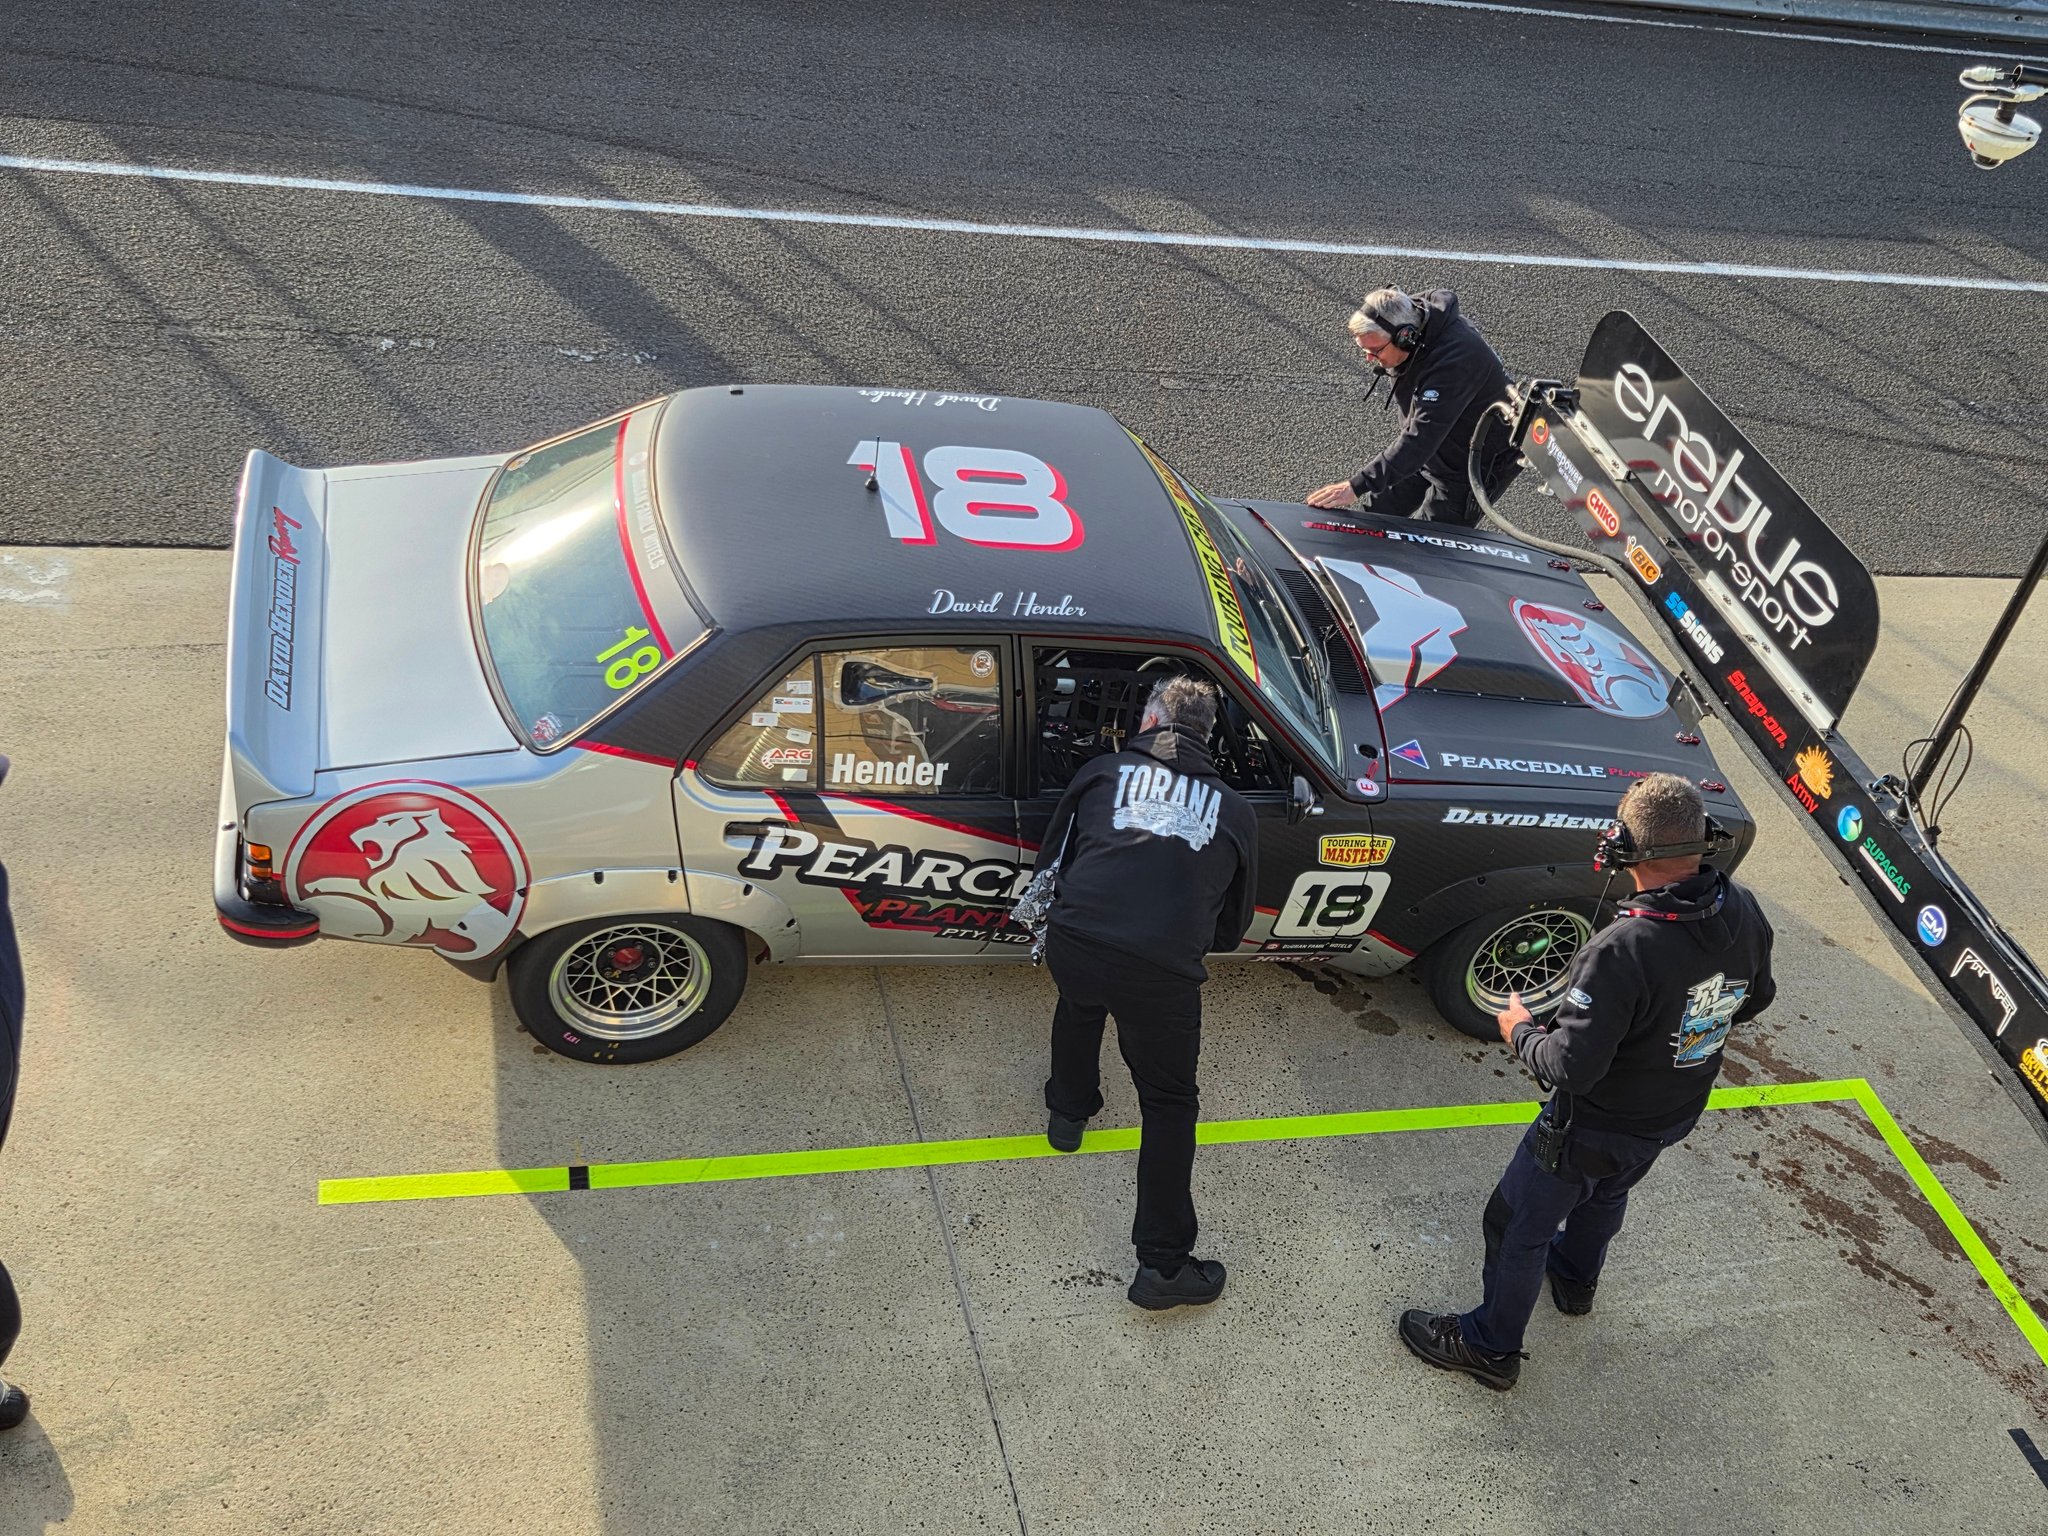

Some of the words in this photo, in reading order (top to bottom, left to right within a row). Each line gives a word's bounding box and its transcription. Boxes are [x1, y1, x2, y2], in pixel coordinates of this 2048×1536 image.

[846, 441, 1085, 552] 18
[1589, 494, 1617, 531] CHIKO
[1614, 363, 1839, 626] erebus
[1181, 505, 1215, 551] CAR
[1385, 530, 1532, 564] PEARCEDALE
[1655, 468, 1812, 650] motorsport
[269, 557, 297, 644] HENDER
[927, 589, 1004, 615] David
[1012, 589, 1088, 617] Hender
[1202, 551, 1254, 661] TOURING
[265, 634, 293, 711] DAVID
[596, 626, 661, 689] 18
[1727, 669, 1788, 744] Snap-on
[770, 748, 812, 759] ARG
[832, 753, 949, 786] Hender
[1440, 752, 1607, 778] PEARCEDALE
[1114, 765, 1222, 840] TORANA
[1787, 773, 1819, 814] Army
[1441, 807, 1540, 828] DAVID
[1323, 848, 1386, 864] MASTERS
[1327, 839, 1367, 848] TOURING
[1369, 839, 1387, 848] CAR
[1862, 836, 1911, 895] SUPAGAS
[1296, 884, 1374, 927] 18
[1921, 911, 1944, 939] CM
[942, 928, 987, 940] PTY
[993, 932, 1030, 944] LTD
